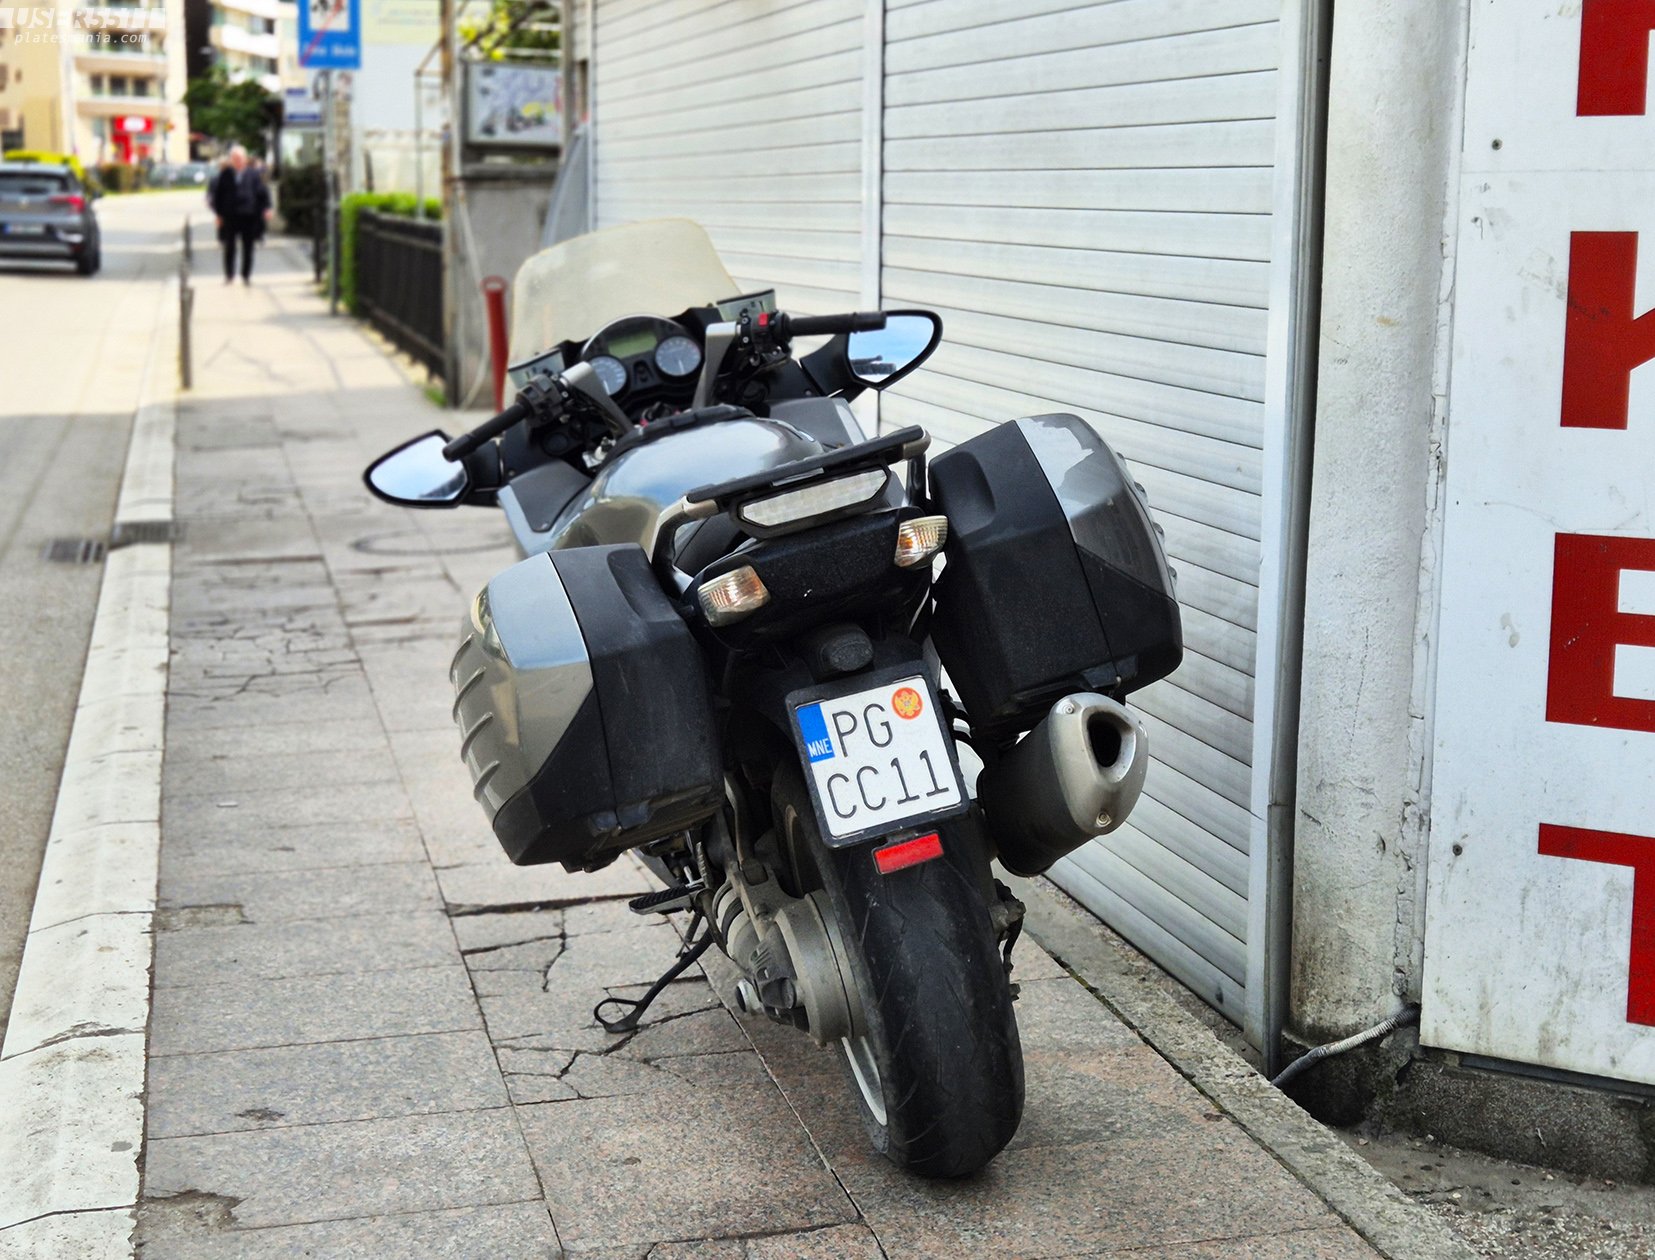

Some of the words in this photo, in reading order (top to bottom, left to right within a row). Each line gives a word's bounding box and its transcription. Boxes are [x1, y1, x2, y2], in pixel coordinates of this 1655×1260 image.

[807, 738, 833, 758] MNE
[831, 703, 894, 758] PG
[826, 749, 950, 819] CC11
